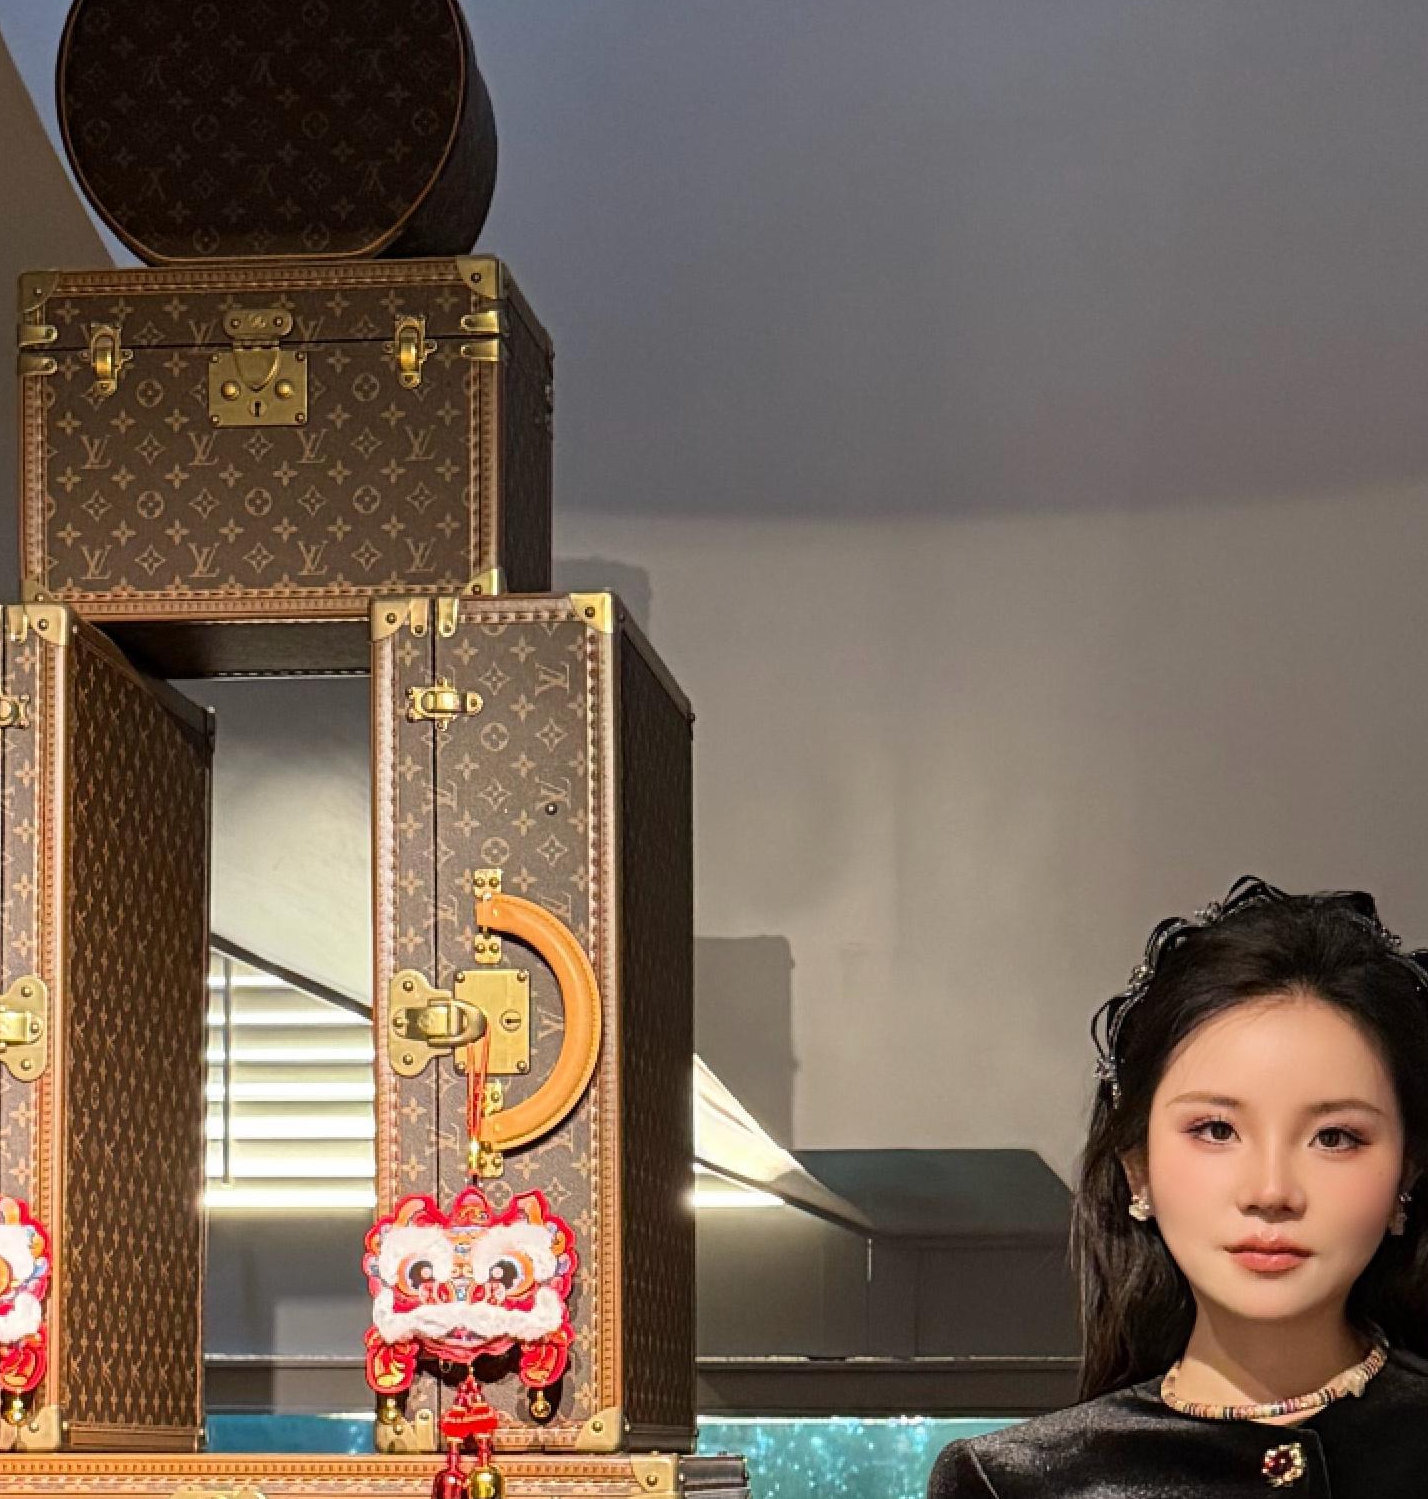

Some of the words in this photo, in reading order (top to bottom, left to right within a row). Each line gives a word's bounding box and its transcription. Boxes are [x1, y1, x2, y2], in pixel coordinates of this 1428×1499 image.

[80, 434, 113, 469] LV
[188, 431, 220, 466] LV
[297, 429, 327, 463] LV
[404, 426, 436, 461] LV
[80, 544, 113, 580] LV
[188, 542, 221, 577] LV
[297, 541, 328, 575] LV
[404, 538, 436, 574] LV
